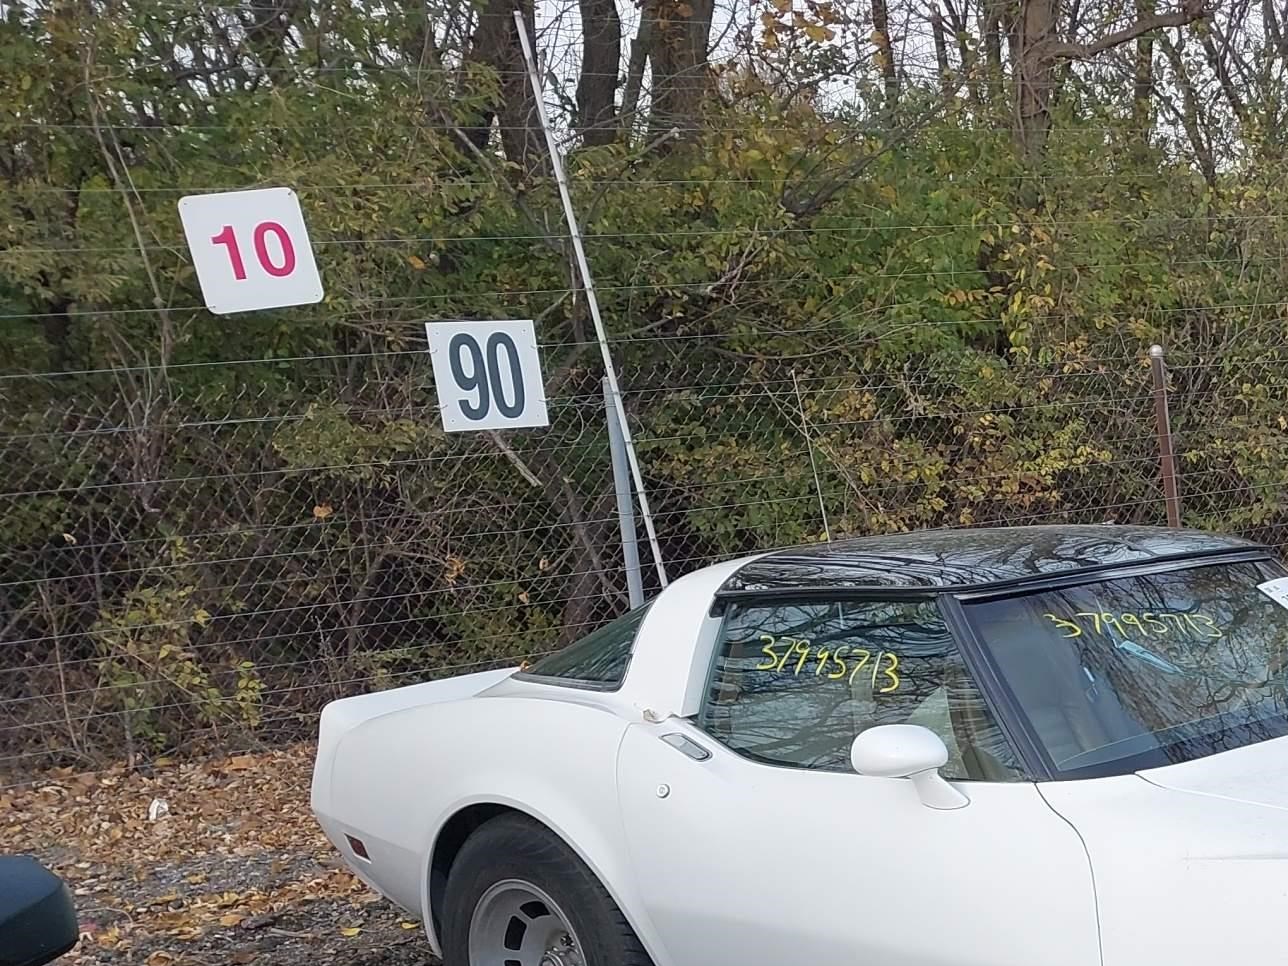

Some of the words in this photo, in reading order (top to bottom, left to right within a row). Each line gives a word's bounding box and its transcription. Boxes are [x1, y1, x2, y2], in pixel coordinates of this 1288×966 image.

[210, 221, 297, 281] 10
[449, 331, 526, 421] 90
[1042, 612, 1223, 638] 37995713
[756, 634, 901, 693] 37995713
